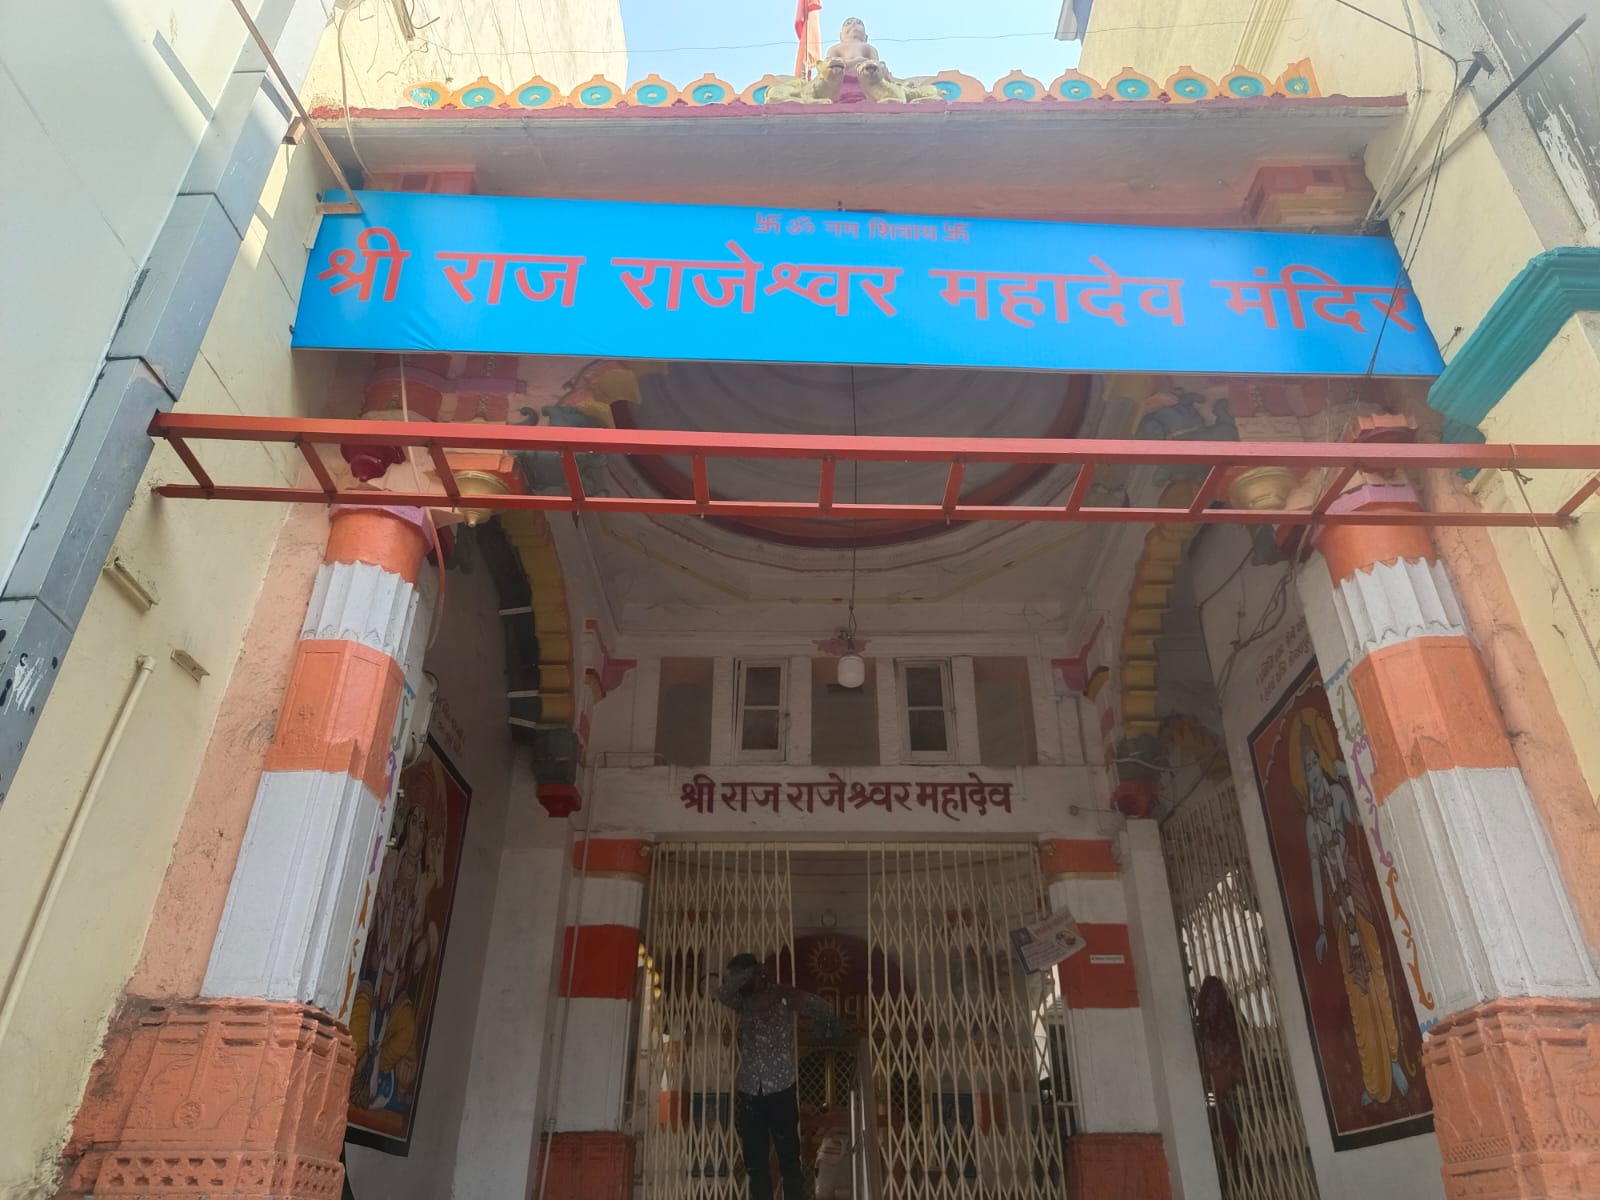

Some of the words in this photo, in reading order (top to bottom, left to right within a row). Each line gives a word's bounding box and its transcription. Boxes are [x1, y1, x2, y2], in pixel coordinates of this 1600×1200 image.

[318, 227, 411, 302] श्री
[436, 251, 587, 307] राज
[611, 240, 903, 317] राजेश्वर
[929, 255, 1185, 328] महादेव
[1210, 263, 1417, 334] मंदिर
[680, 773, 716, 814] श्री
[915, 772, 1014, 821] महादेव
